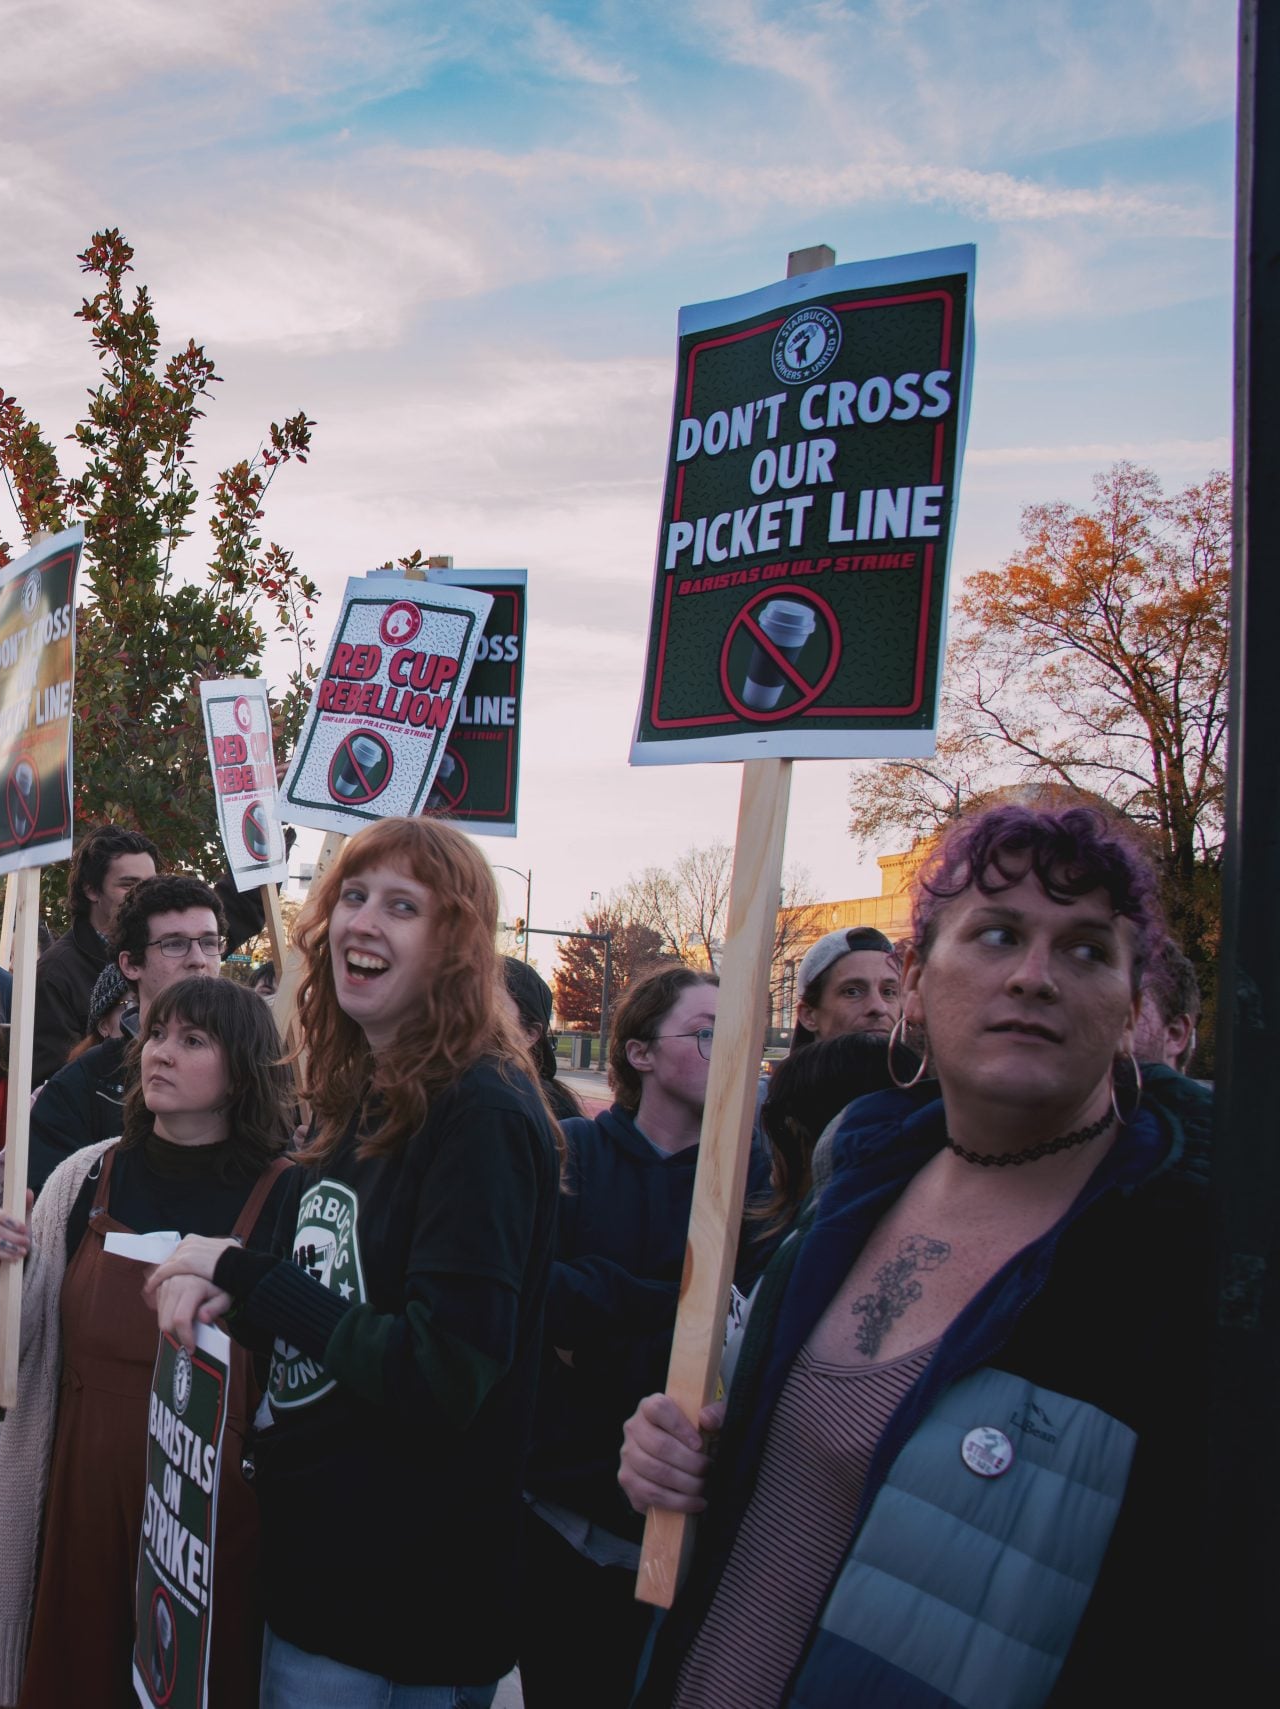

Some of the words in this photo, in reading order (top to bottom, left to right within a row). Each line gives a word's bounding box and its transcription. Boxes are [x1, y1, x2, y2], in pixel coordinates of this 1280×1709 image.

[782, 311, 833, 338] STARBUCKS
[775, 350, 802, 380] WORKERS
[811, 338, 837, 373] UNITED
[675, 392, 787, 462] DON'T
[799, 370, 952, 431] CROSS
[749, 438, 837, 496] OUR
[664, 495, 814, 570] PICKET
[828, 485, 944, 543] LINE
[677, 567, 759, 596] BARISTAS
[761, 562, 790, 580] ON
[790, 557, 833, 576] ULP
[833, 552, 916, 573] STRIKE
[329, 642, 382, 681] RED
[388, 648, 459, 694] CUP
[475, 634, 519, 662] OSS
[36, 680, 70, 725] LINE
[316, 679, 453, 731] REBELLION
[459, 696, 516, 726] LINE
[212, 734, 248, 767] RED
[322, 715, 344, 725] UNFAIR
[344, 717, 363, 727] LABOR
[363, 717, 403, 734] PRACTICE
[404, 727, 434, 740] STRIKE
[297, 1194, 351, 1270] ARBUCKS
[149, 1391, 216, 1495] BARISTAS
[163, 1463, 182, 1516] ON
[144, 1483, 210, 1608] STRIKE!
